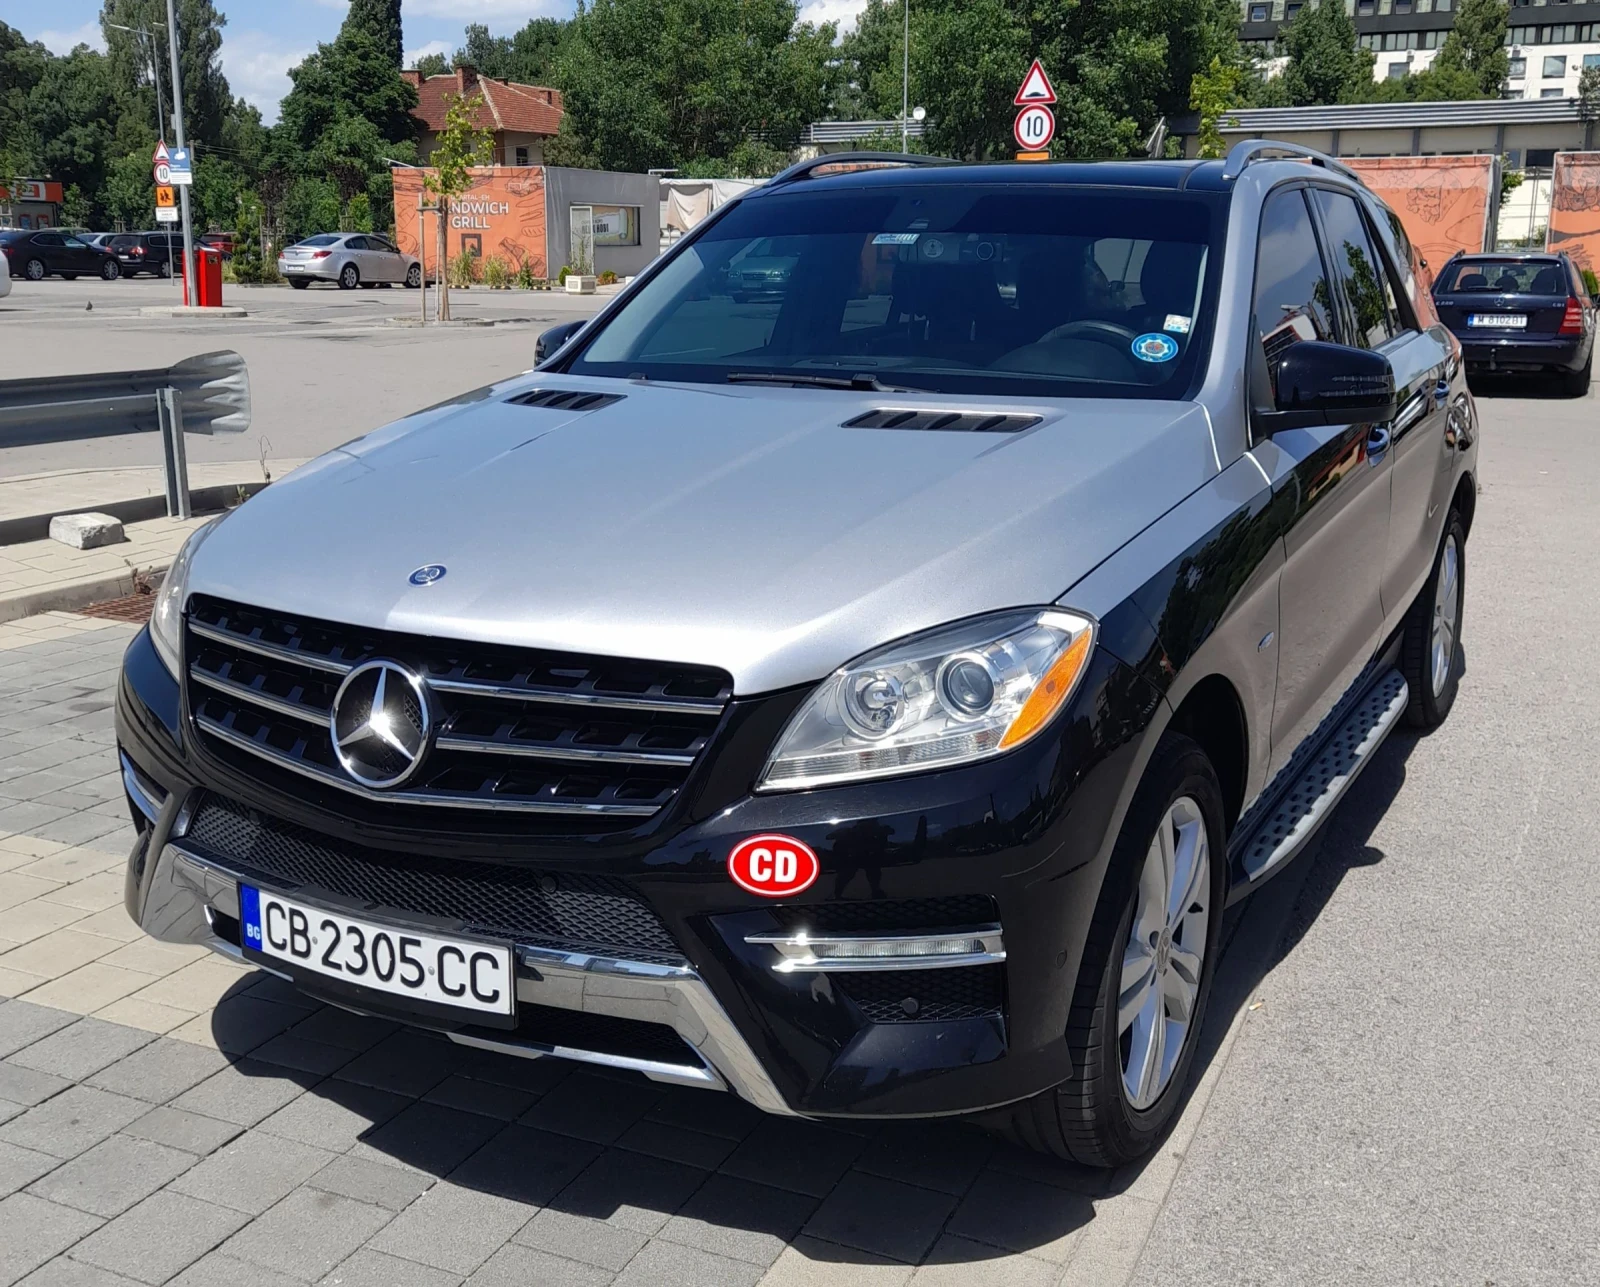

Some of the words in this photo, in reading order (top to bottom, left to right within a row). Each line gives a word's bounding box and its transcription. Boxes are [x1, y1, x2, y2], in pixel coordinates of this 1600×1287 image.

[1026, 115, 1044, 137] 10
[159, 167, 168, 179] 10
[449, 202, 509, 214] NDWICH
[452, 216, 491, 229] GRILL
[749, 848, 798, 883] CD
[246, 922, 261, 941] BG
[265, 901, 311, 959] CB
[320, 919, 425, 988] 2305
[437, 945, 500, 1004] CC
